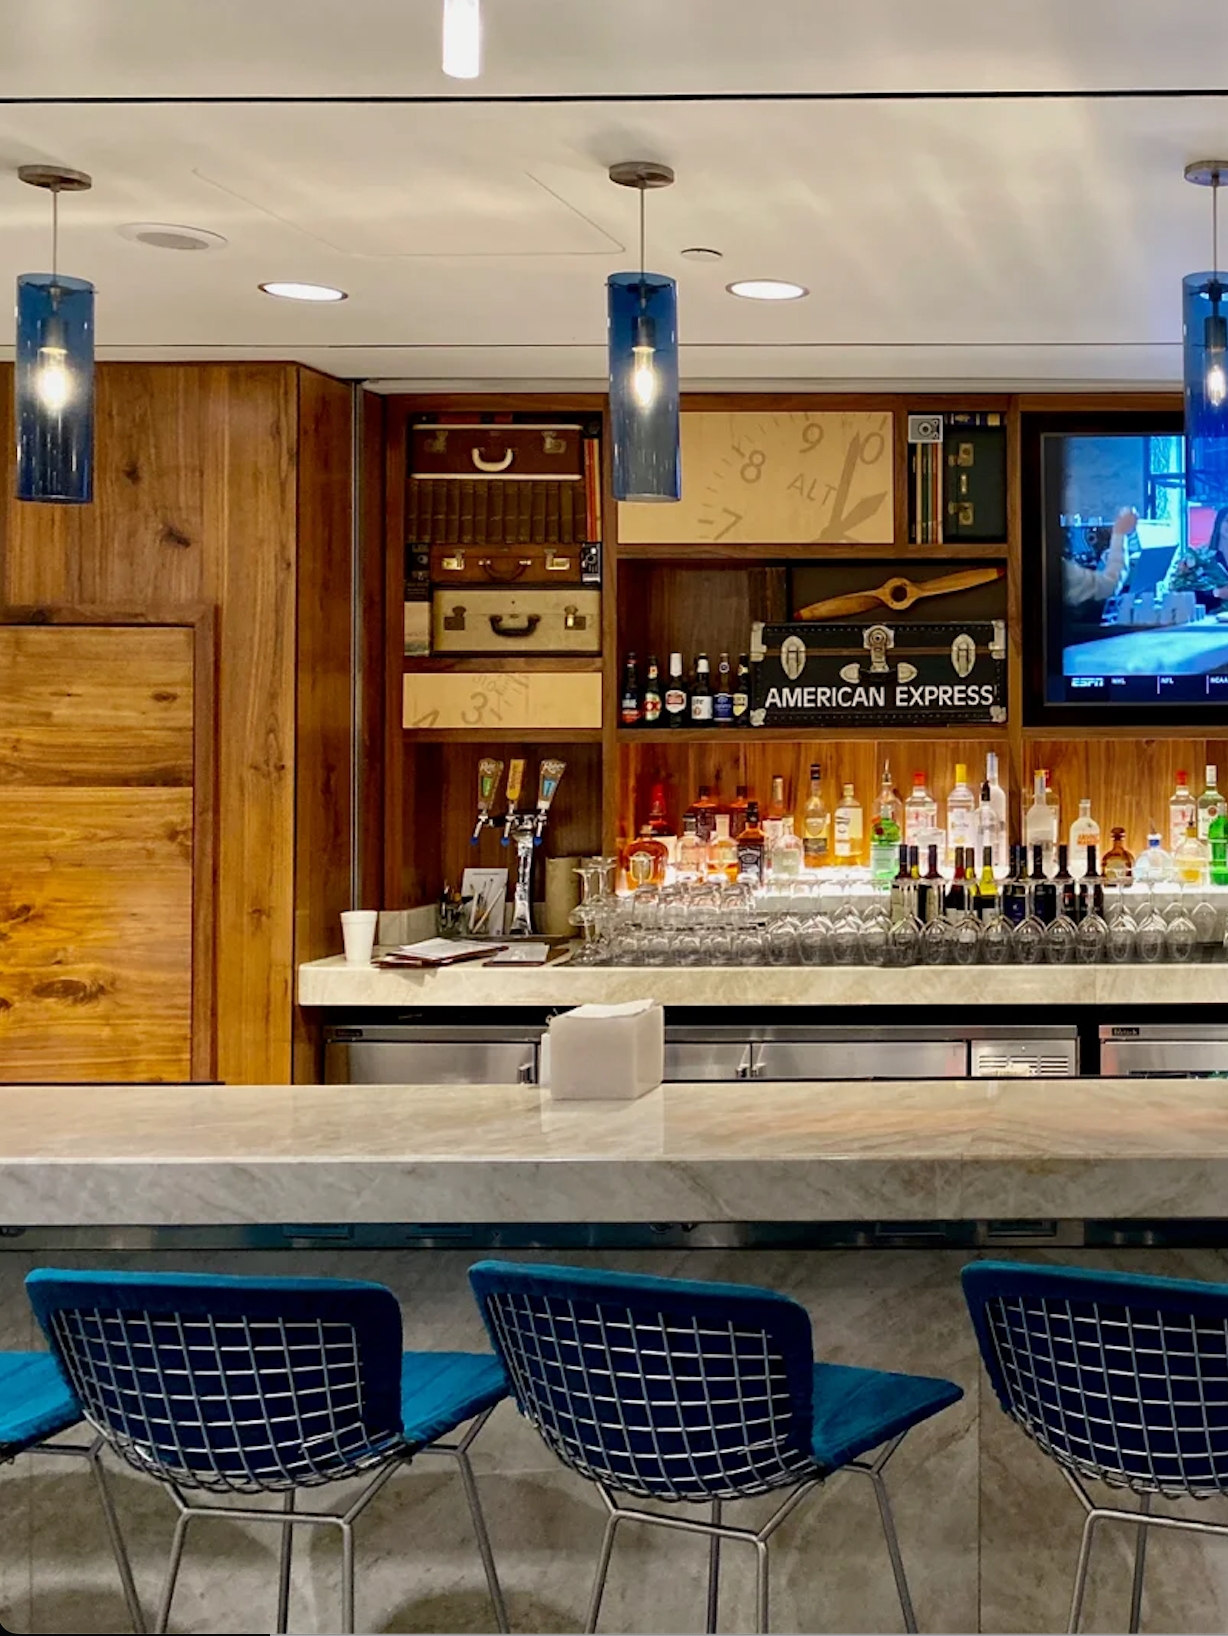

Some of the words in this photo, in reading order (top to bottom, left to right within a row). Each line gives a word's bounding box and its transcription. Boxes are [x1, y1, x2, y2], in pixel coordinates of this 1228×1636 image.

[799, 422, 824, 453] 9
[740, 449, 766, 483] 8
[787, 473, 837, 507] ALT
[765, 686, 886, 708] AMERICAN
[895, 685, 994, 707] EXPRESS
[1071, 677, 1104, 688] ESPN
[461, 691, 488, 725] 3
